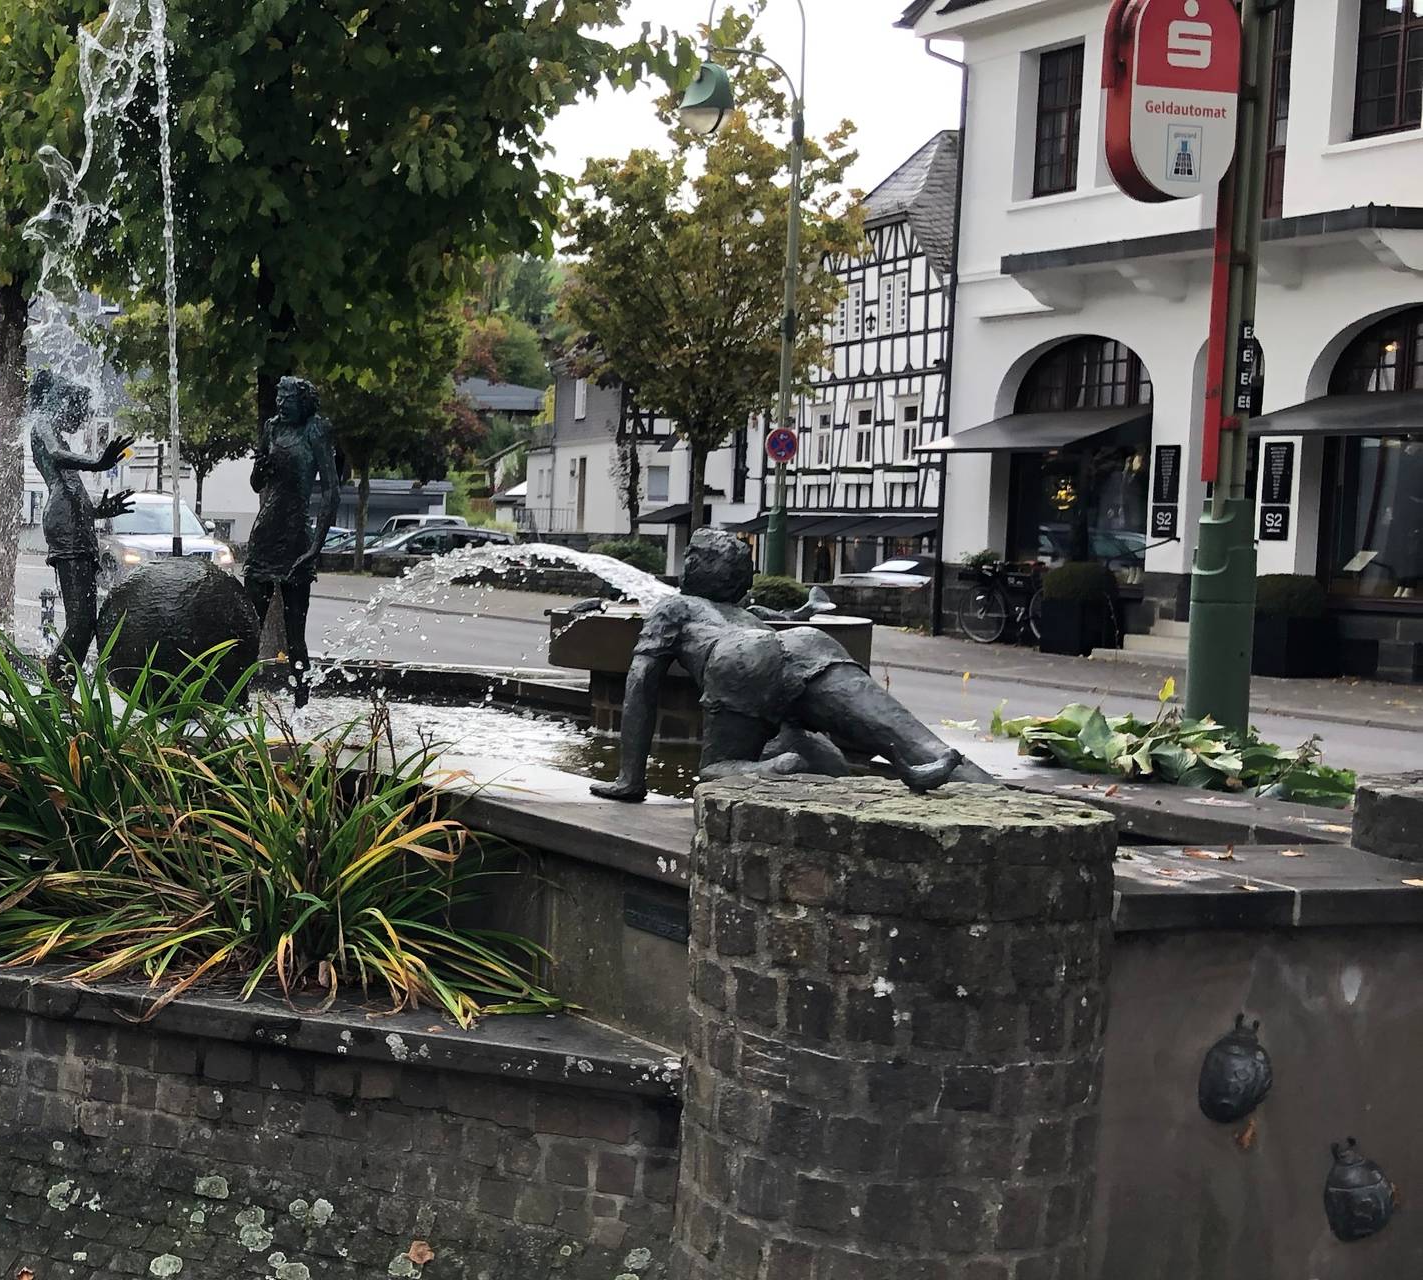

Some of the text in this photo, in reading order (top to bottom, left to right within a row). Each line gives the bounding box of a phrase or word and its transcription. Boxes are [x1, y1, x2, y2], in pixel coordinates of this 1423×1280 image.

[1145, 100, 1227, 119] Geldautomat
[1242, 349, 1253, 362] E
[1156, 511, 1172, 525] S2
[1265, 513, 1282, 527] S2
